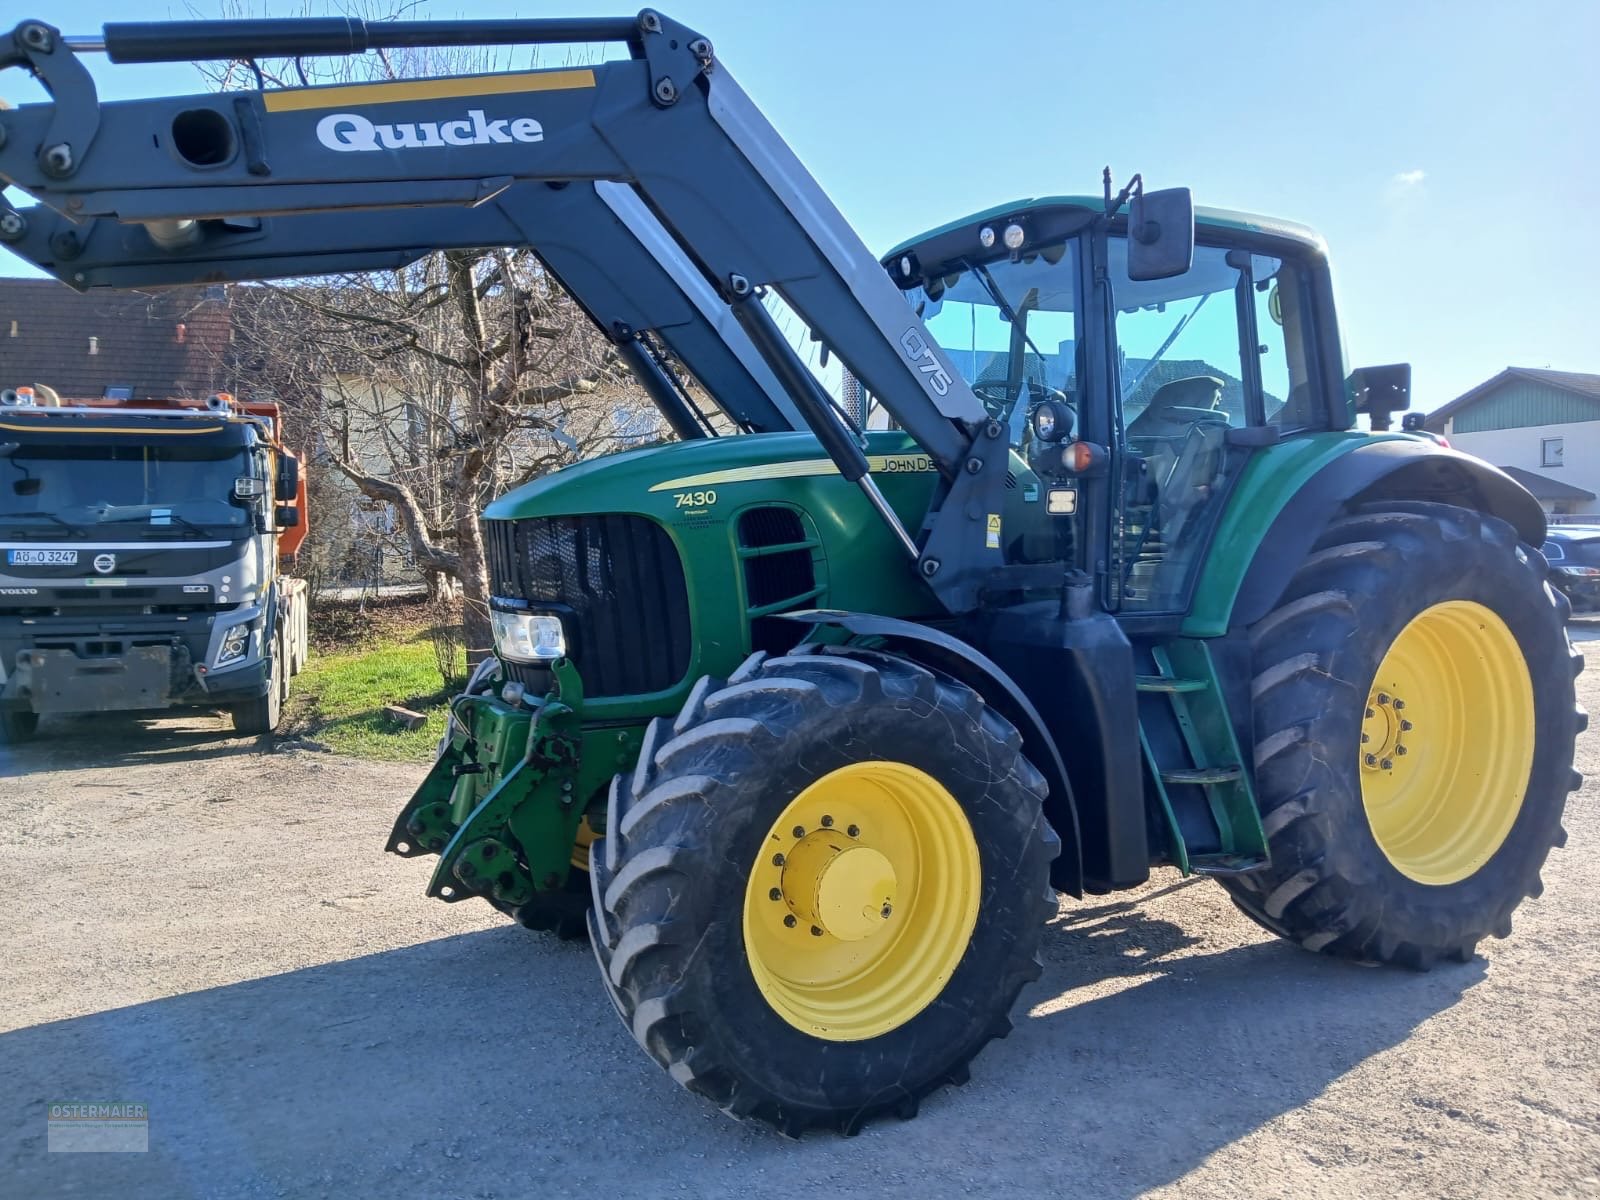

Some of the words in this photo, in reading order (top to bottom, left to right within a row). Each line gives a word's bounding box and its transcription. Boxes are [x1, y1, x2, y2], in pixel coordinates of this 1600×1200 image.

[316, 109, 544, 152] Quicke
[900, 326, 953, 397] Q75
[881, 458, 916, 471] JOHN
[673, 490, 717, 508] 7430
[48, 551, 76, 562] 3247
